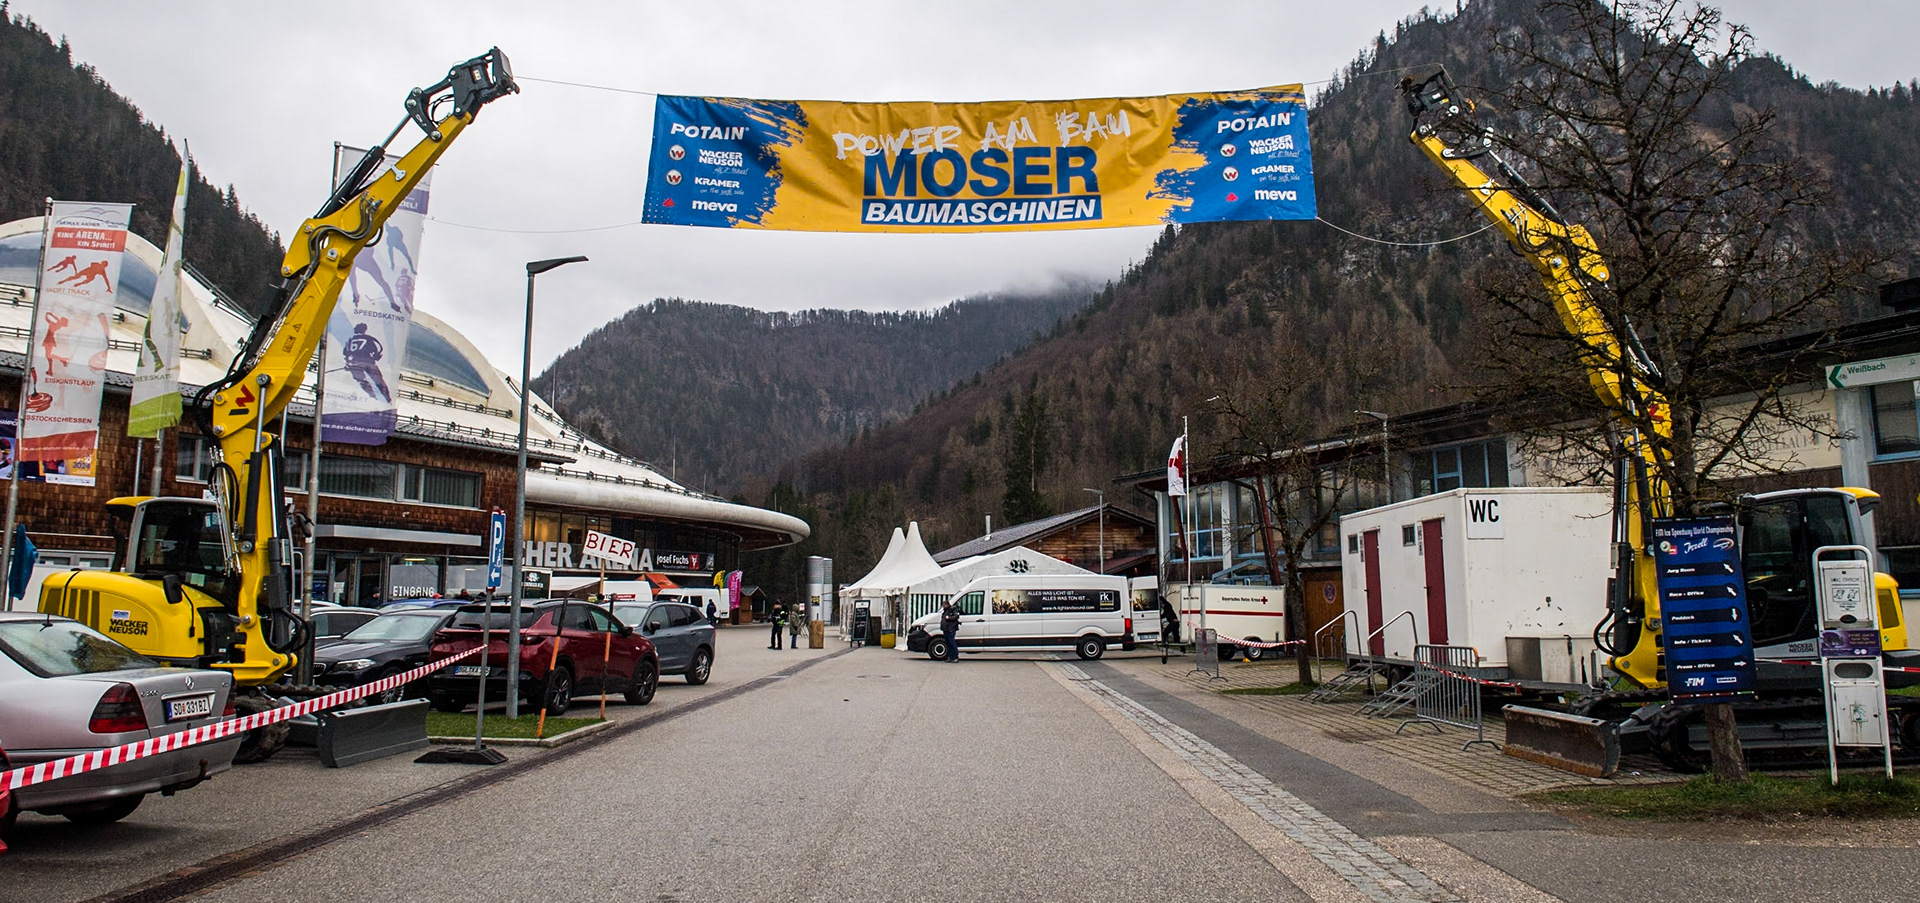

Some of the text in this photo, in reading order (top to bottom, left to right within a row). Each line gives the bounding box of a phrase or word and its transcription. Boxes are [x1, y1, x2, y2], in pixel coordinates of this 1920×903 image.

[1217, 112, 1290, 133] POTAIN
[670, 122, 744, 140] POTAIN
[832, 109, 1131, 160] POWER AM BAU
[1248, 134, 1292, 148] WACKER
[699, 148, 743, 160] WACKER
[1250, 142, 1294, 155] NEUSON
[698, 156, 743, 167] NEUSON
[863, 146, 1100, 197] MOSER
[1251, 165, 1295, 175] KRAMER
[694, 177, 740, 188] KRAMER
[1254, 189, 1297, 201] meva
[692, 200, 738, 212] meva
[865, 200, 1096, 223] BAUMASCHINEN
[57, 231, 75, 239] EINE
[353, 308, 405, 323] SPEEDSKATING
[350, 338, 368, 352] 67
[1847, 362, 1886, 374] Weißbach
[45, 377, 96, 387] EISKUNSTLAUF
[1469, 499, 1499, 523] WC
[1671, 526, 1693, 538] Speedway
[1693, 525, 1706, 534] World
[1706, 526, 1735, 535] Championship
[493, 521, 502, 563] P
[586, 533, 633, 558] BIER
[521, 540, 573, 567] HER
[672, 555, 690, 565] Fuchs
[392, 586, 435, 598] EINGANG
[110, 619, 148, 628] WACKER
[109, 626, 147, 635] NEUSON
[1686, 677, 1705, 687] FIM
[173, 702, 183, 716] SD
